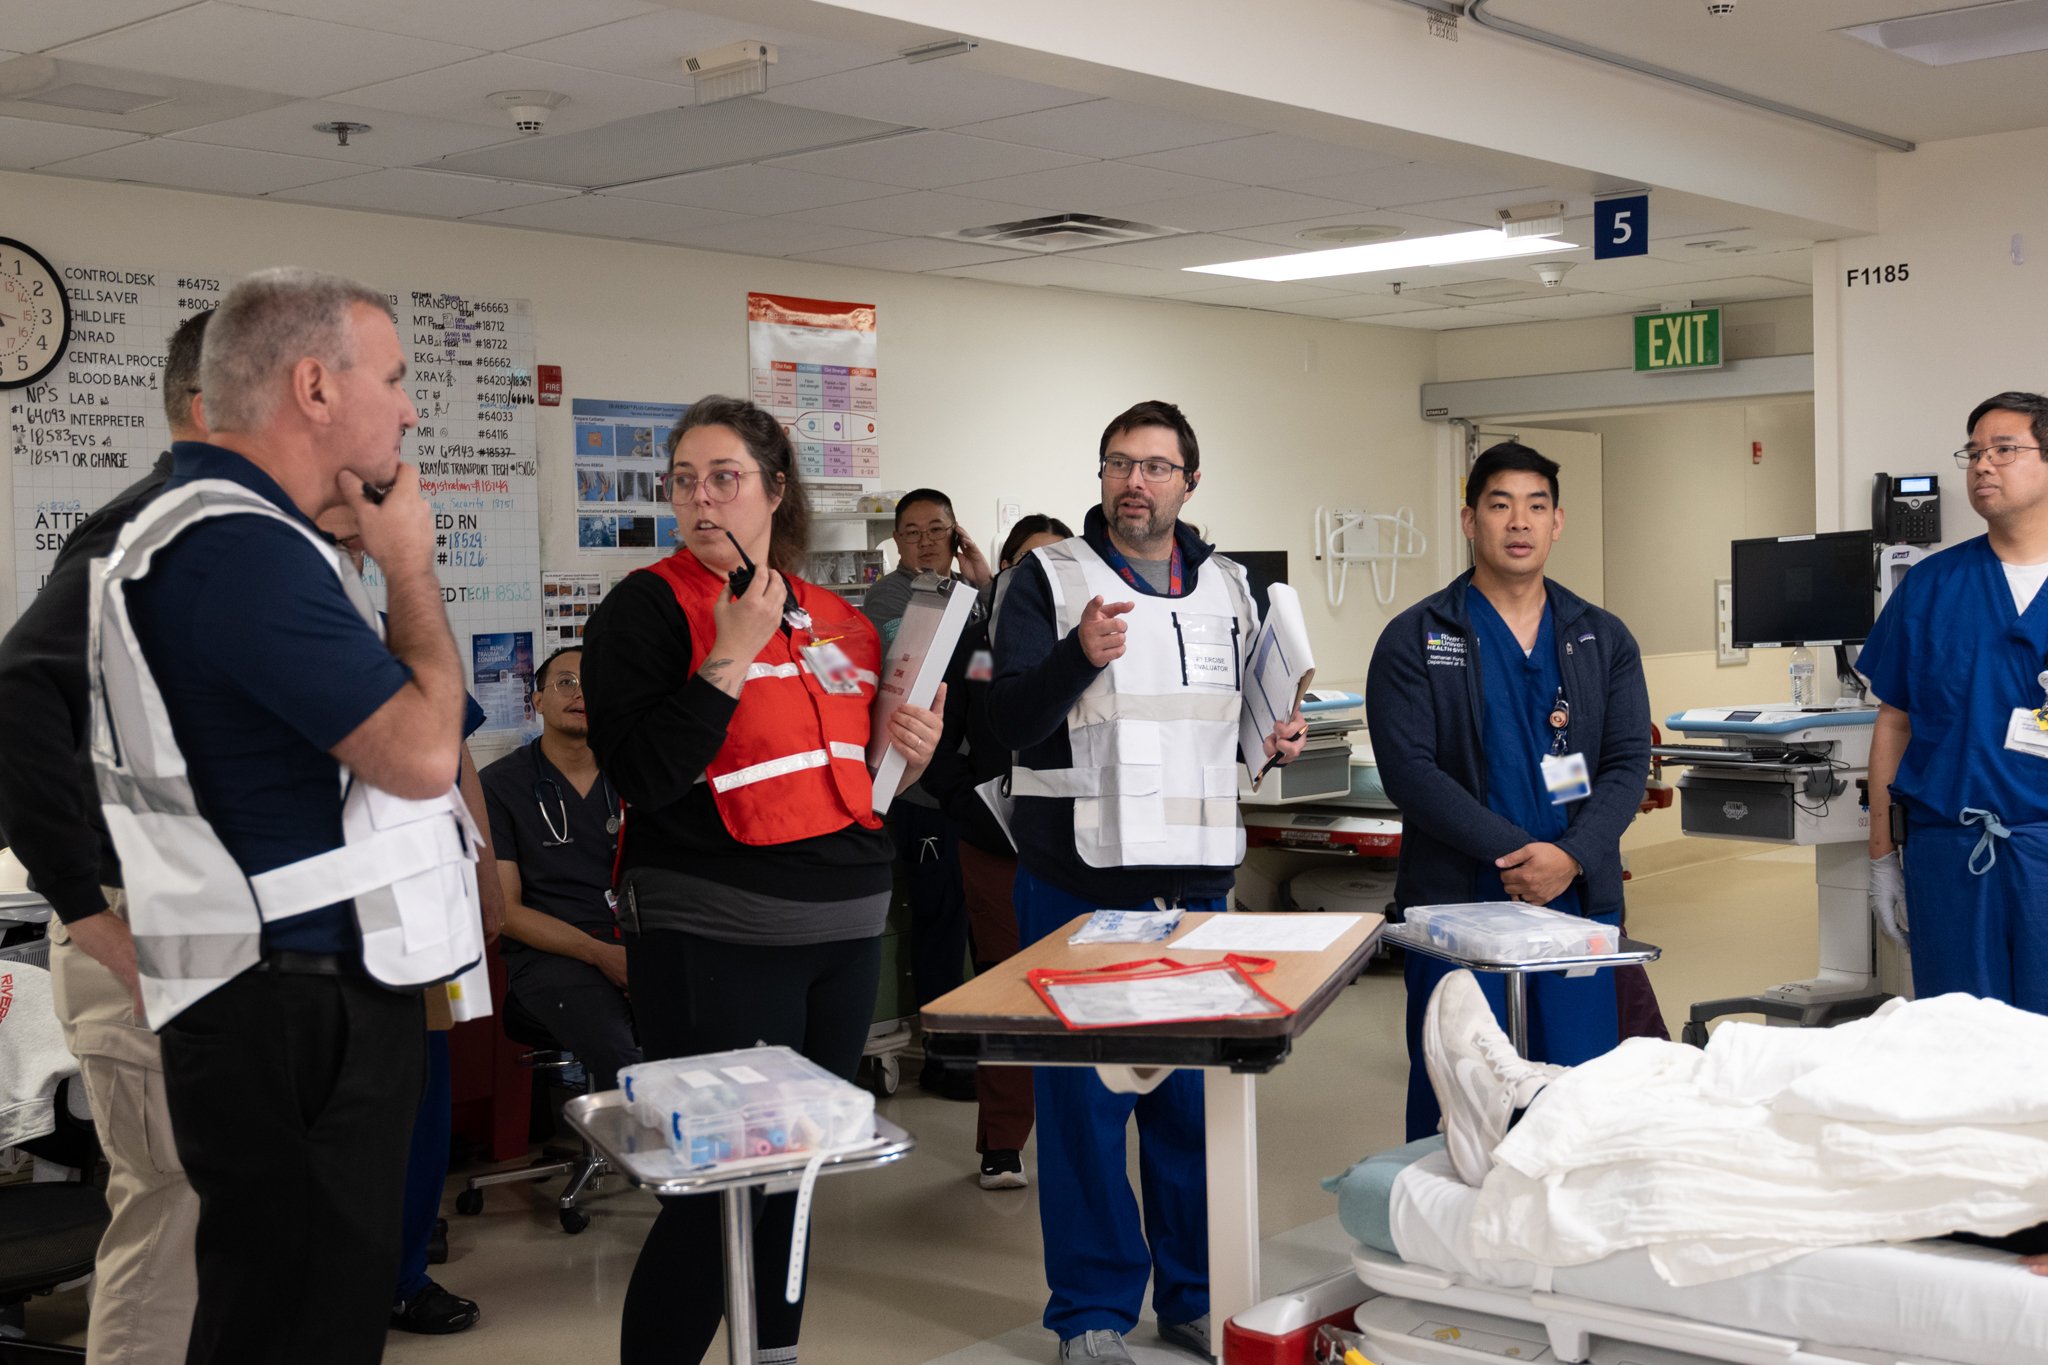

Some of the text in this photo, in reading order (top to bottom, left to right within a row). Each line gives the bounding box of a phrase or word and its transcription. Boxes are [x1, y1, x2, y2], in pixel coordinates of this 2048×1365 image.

[1612, 211, 1632, 244] 5
[14, 260, 23, 276] 1
[1847, 263, 1909, 287] F1185
[65, 267, 220, 292] CONTROL DESK #64752
[33, 280, 44, 297] 2
[66, 288, 98, 302] CELL
[97, 291, 138, 305] SAVER
[413, 298, 509, 313] TRANSPORT #66663
[23, 310, 33, 322] 15
[41, 308, 52, 325] 3
[103, 312, 126, 326] LIFE
[413, 315, 434, 326] MTP
[475, 320, 505, 332] #18712
[36, 335, 48, 351] 4
[414, 333, 434, 345] LAB
[475, 339, 508, 350] #18722
[1648, 314, 1708, 367] EXIT
[18, 355, 28, 371] 5
[69, 351, 124, 366] CENTRAL
[414, 353, 434, 364] EKG
[476, 357, 511, 368] #66662
[68, 372, 146, 388] BLOOD BANK
[416, 371, 444, 382] XRAY
[545, 383, 561, 391] FIRE
[70, 393, 95, 405] LAB
[416, 389, 428, 400] CT
[70, 413, 145, 428] INTERPRETER
[417, 408, 513, 422] US #64033
[417, 426, 508, 440] MRI #64116
[71, 434, 96, 447] EVS
[418, 445, 435, 456] SW
[72, 453, 129, 469] OR CHARGE
[451, 462, 489, 475] TRANSPORT
[492, 464, 509, 475] TECH
[435, 514, 477, 530] ED RN
